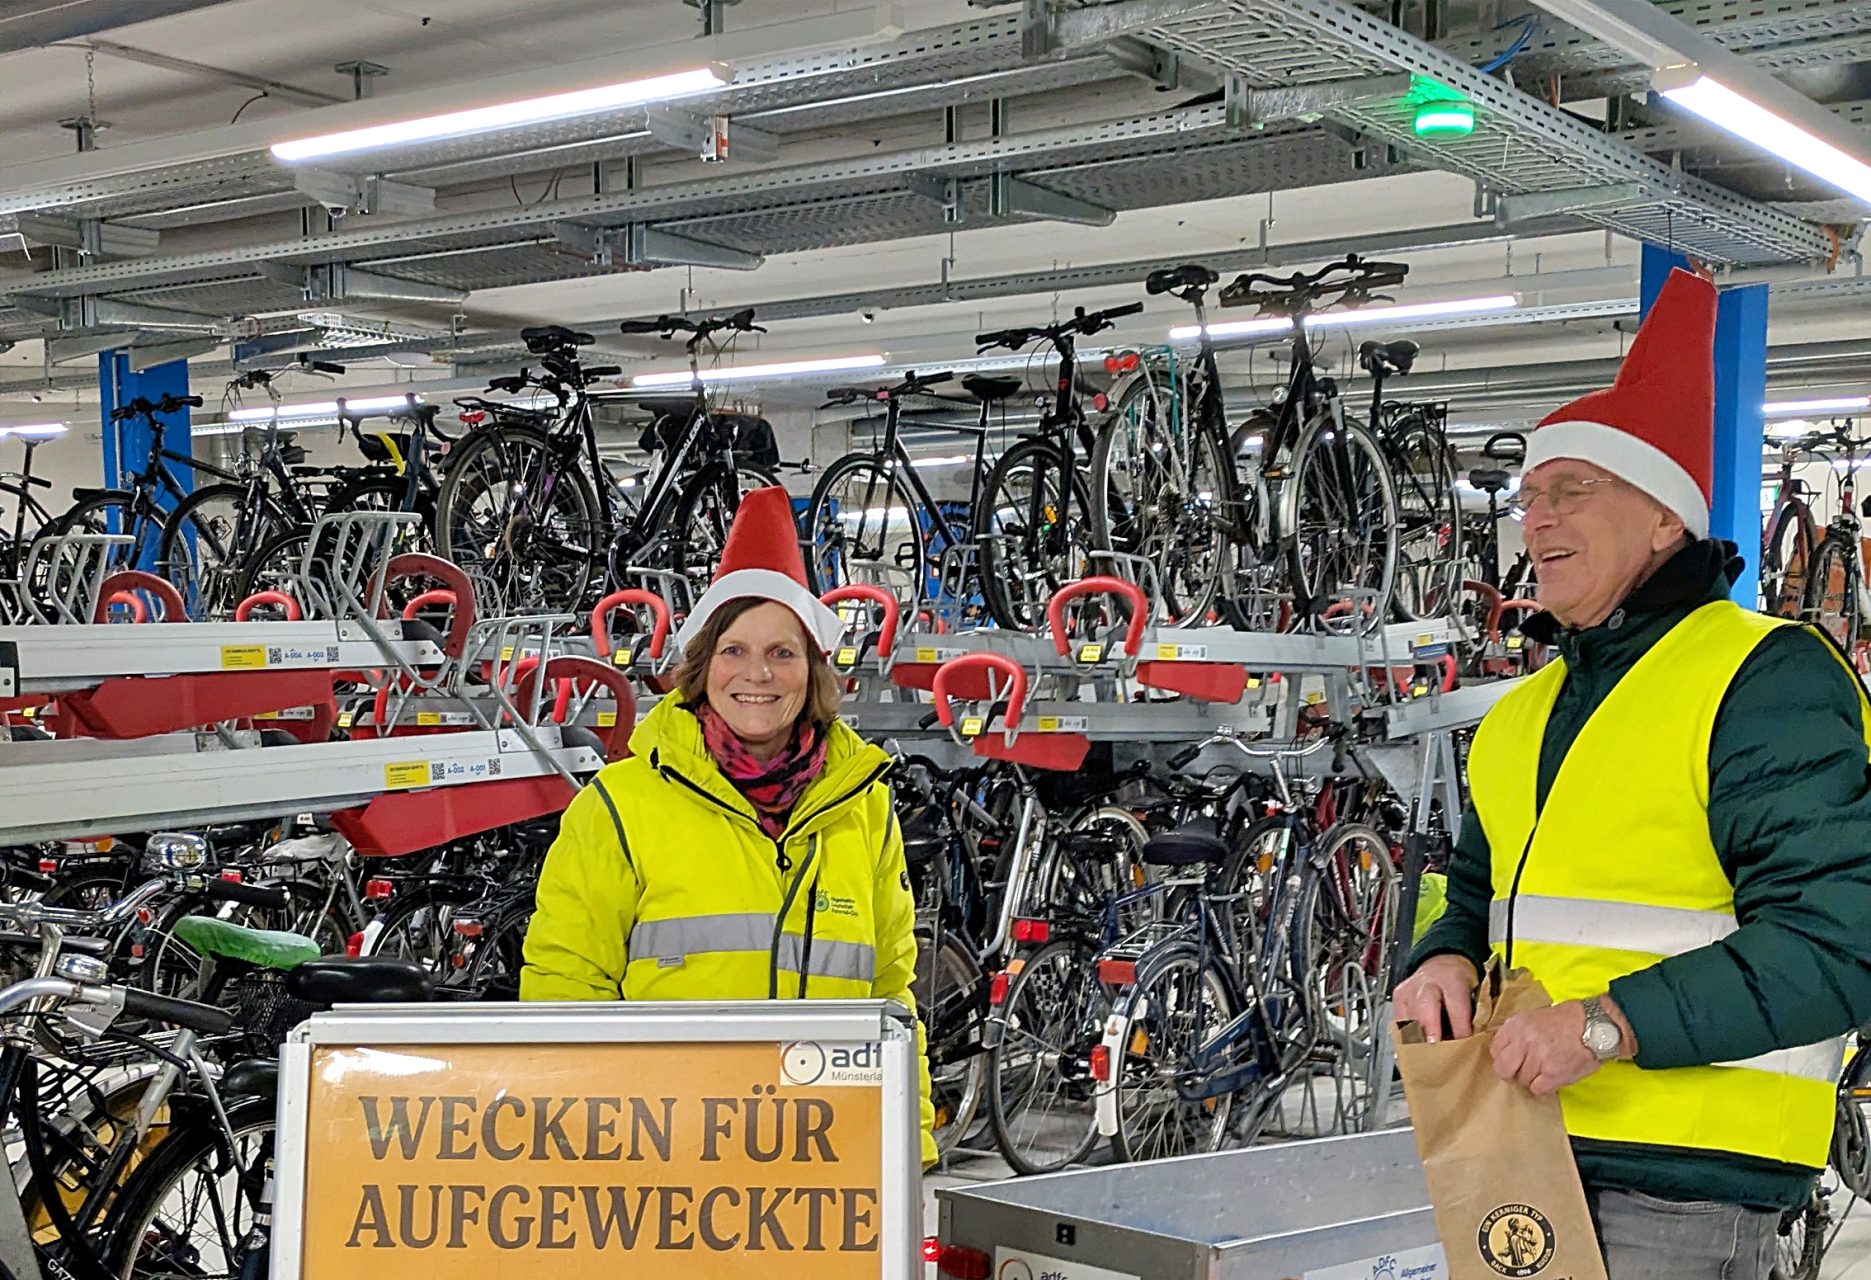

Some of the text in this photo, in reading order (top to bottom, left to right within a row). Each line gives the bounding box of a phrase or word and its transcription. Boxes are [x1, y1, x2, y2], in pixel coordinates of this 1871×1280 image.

[831, 1042, 882, 1068] adf
[359, 1083, 840, 1163] WECKEN FÜR
[345, 1184, 879, 1252] AUFGEWECKTE
[1490, 1205, 1529, 1221] KERNIGER
[1530, 1209, 1543, 1222] TYP
[1372, 1256, 1397, 1276] ADFC
[1490, 1259, 1507, 1274] BACK
